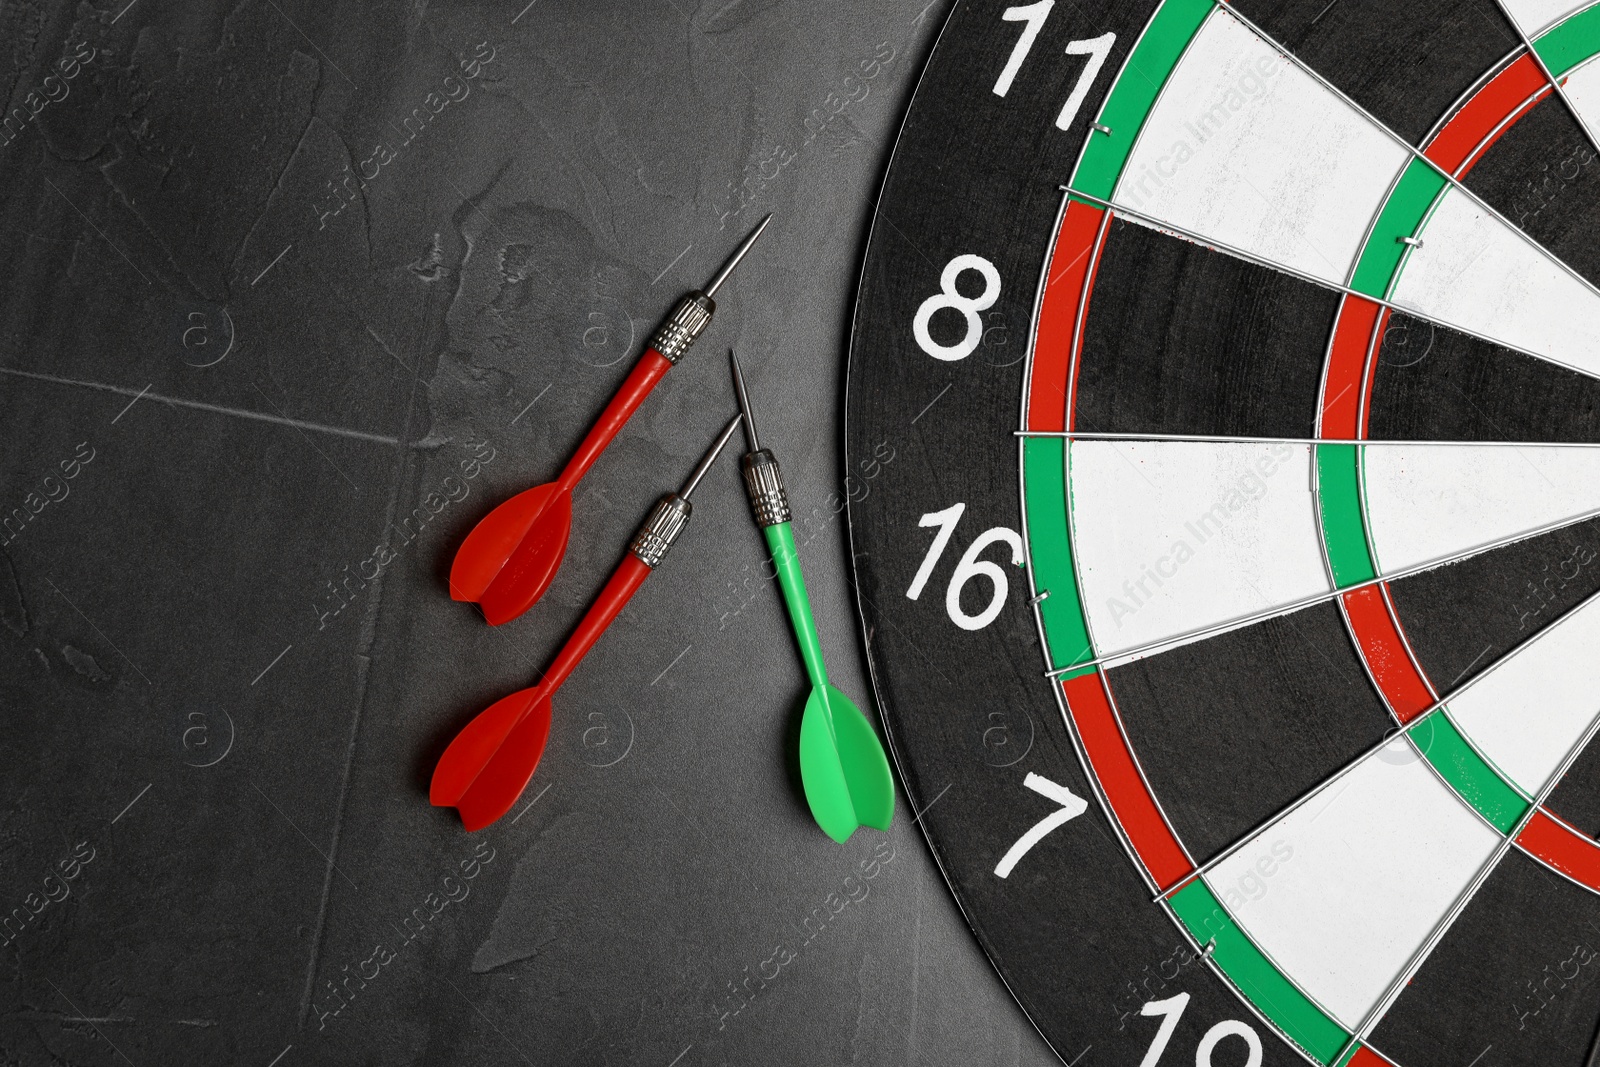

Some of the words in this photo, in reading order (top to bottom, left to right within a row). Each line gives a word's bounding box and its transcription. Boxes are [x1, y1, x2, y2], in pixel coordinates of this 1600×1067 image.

[992, 0, 1117, 132] 11
[912, 254, 1001, 362] 8
[905, 502, 1023, 631] 16
[994, 772, 1089, 879] 7
